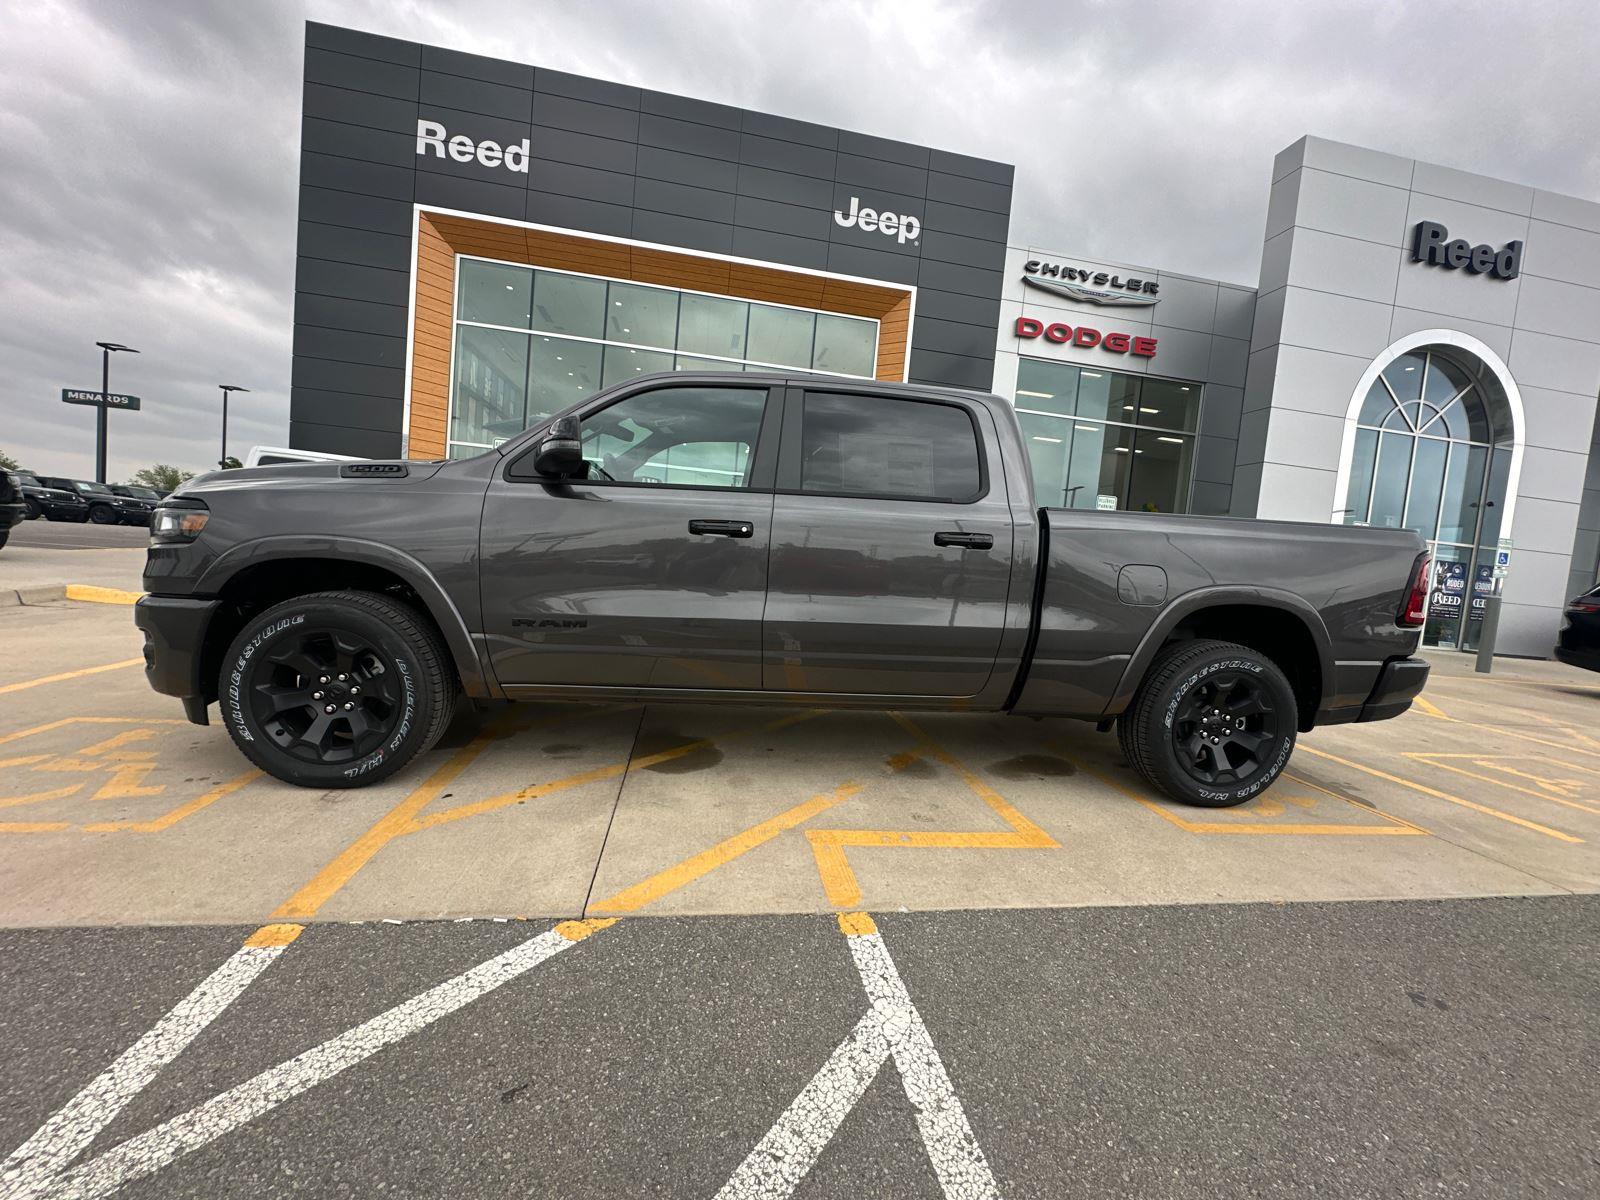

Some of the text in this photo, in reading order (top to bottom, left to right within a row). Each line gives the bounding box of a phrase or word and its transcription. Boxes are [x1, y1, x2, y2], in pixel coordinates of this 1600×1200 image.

[416, 119, 530, 173] Reed
[834, 196, 920, 245] Jeep
[1411, 220, 1523, 281] Reed
[1024, 260, 1159, 294] CHRYSLER
[1015, 317, 1159, 358] DODGE
[511, 617, 588, 629] RAM
[1432, 591, 1461, 606] REED
[229, 614, 305, 742] BRIDGESTONE
[1165, 660, 1263, 729] BRIDGESTONE
